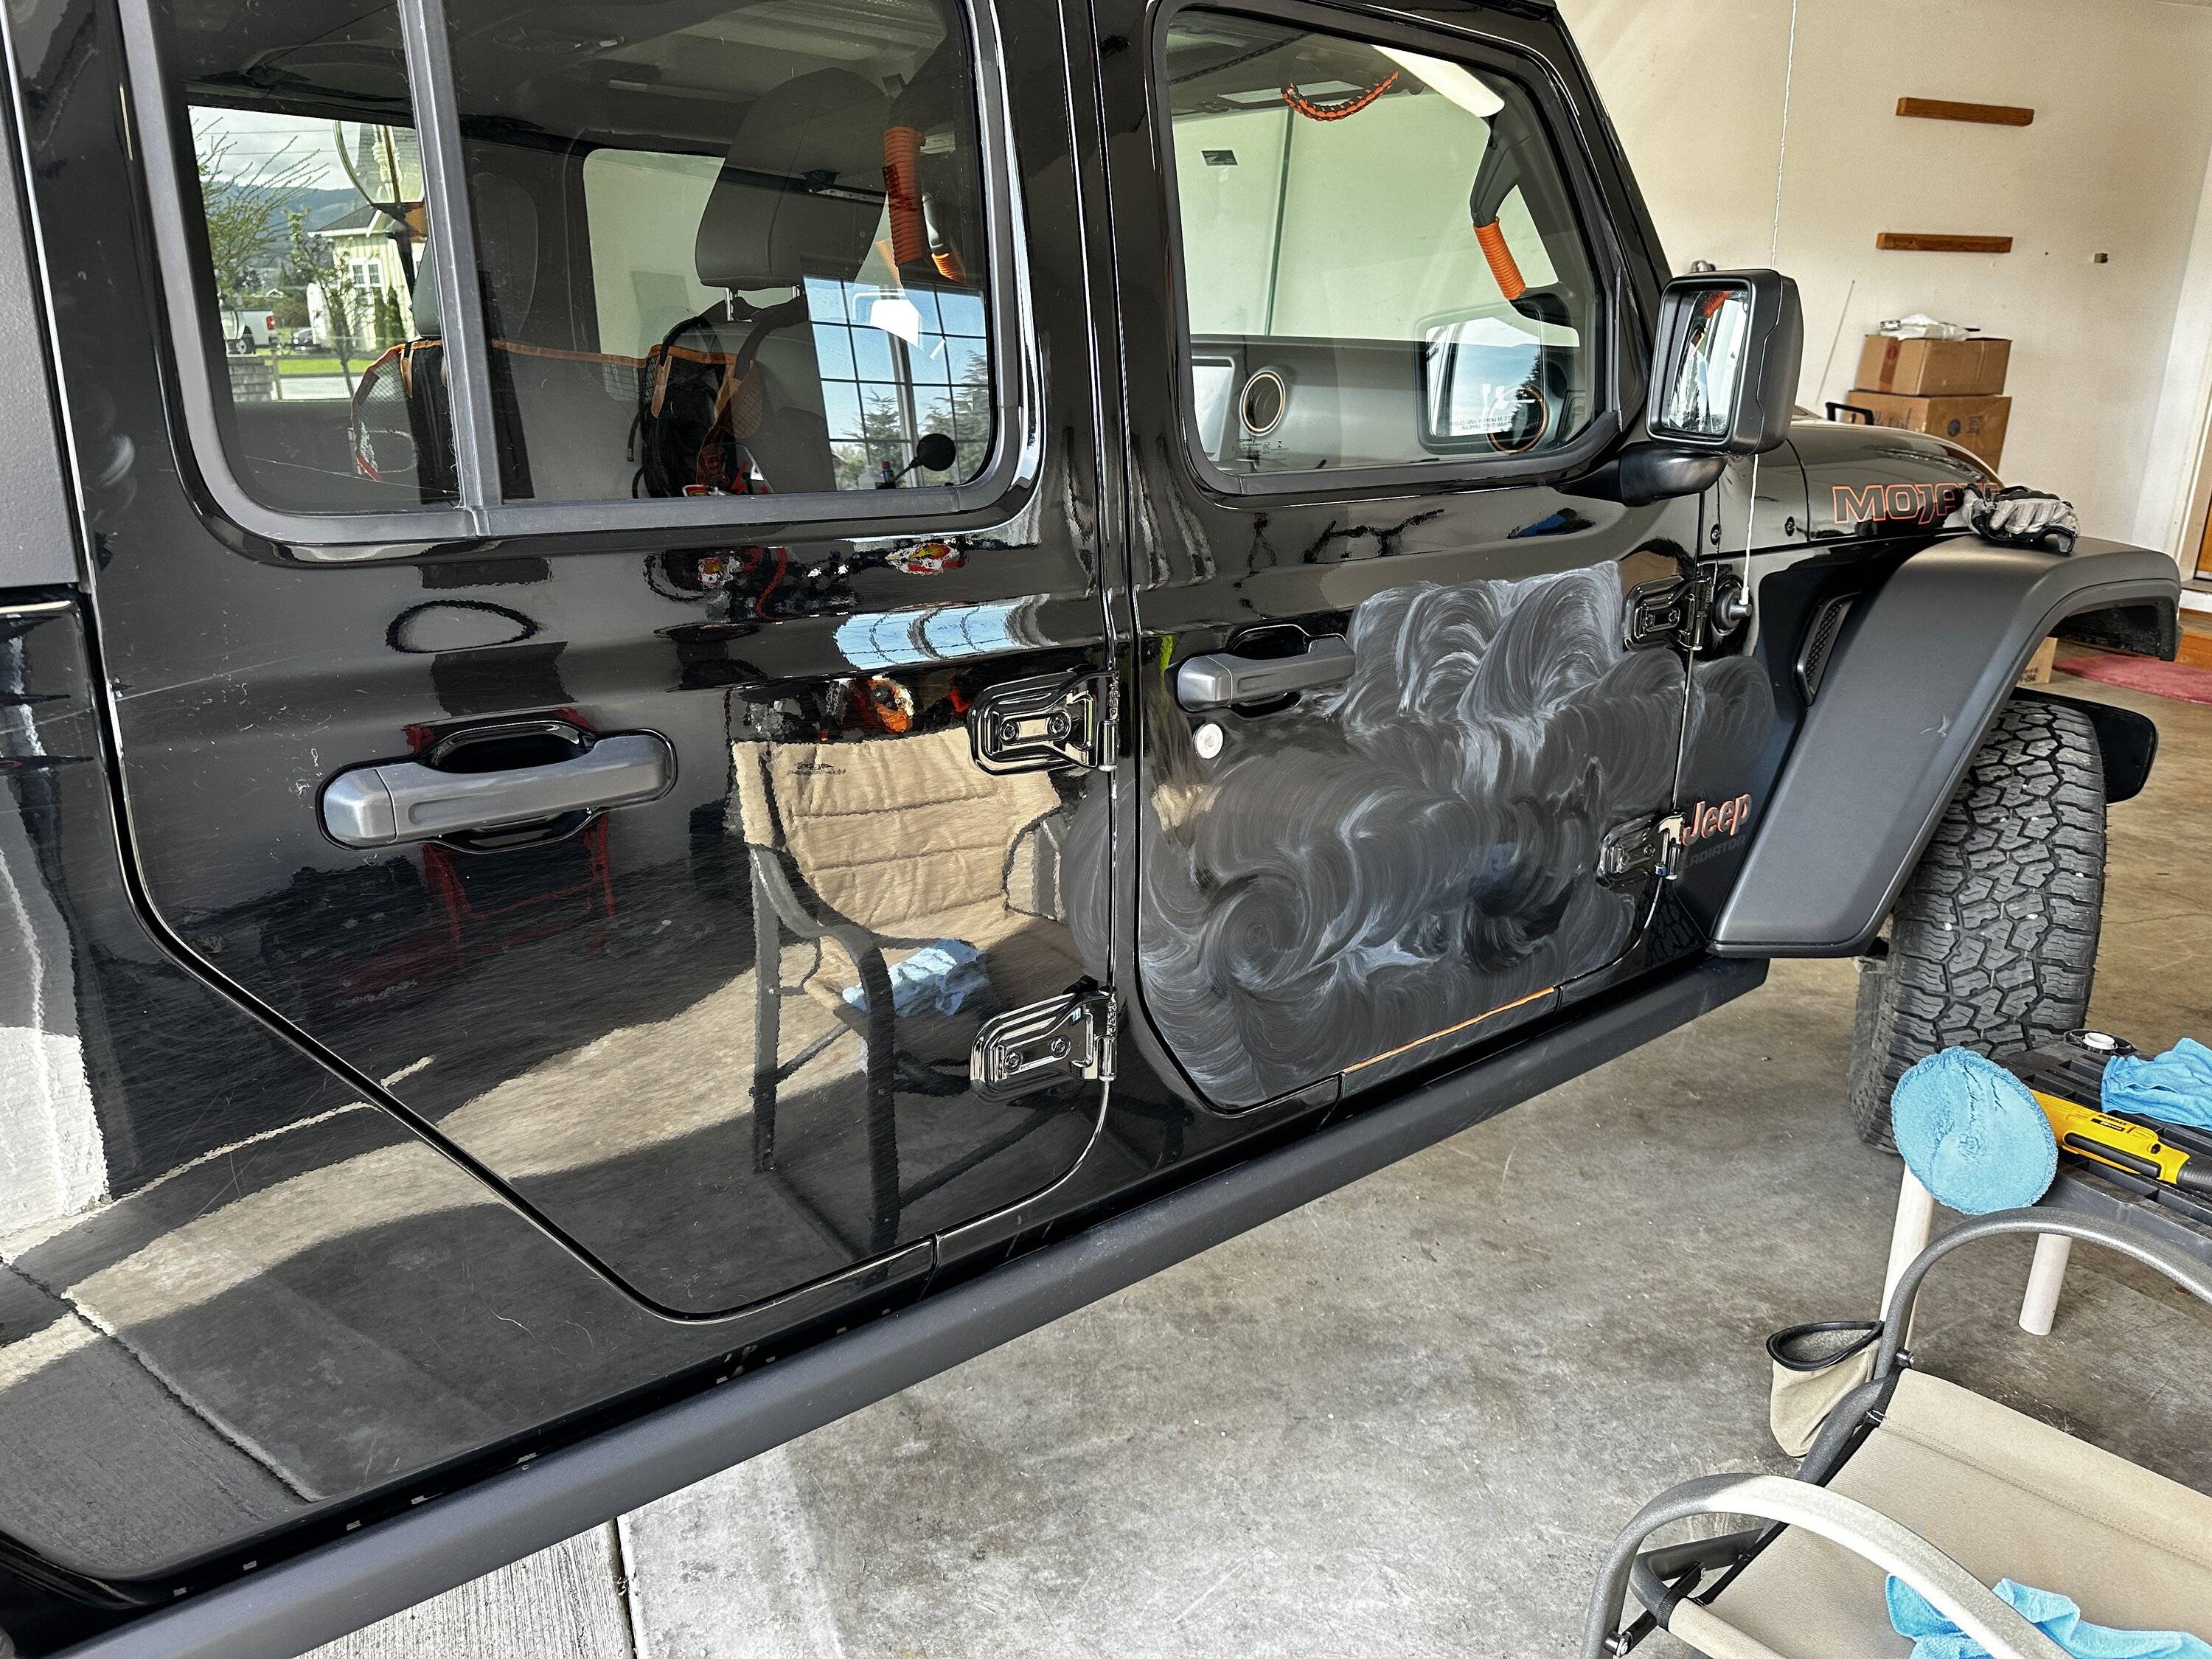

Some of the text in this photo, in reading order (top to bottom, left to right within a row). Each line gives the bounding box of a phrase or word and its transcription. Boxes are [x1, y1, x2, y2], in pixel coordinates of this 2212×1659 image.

[1832, 483, 2000, 524] MOJA
[1681, 793, 1752, 846] Jeep
[1685, 834, 1746, 867] ADIATOR
